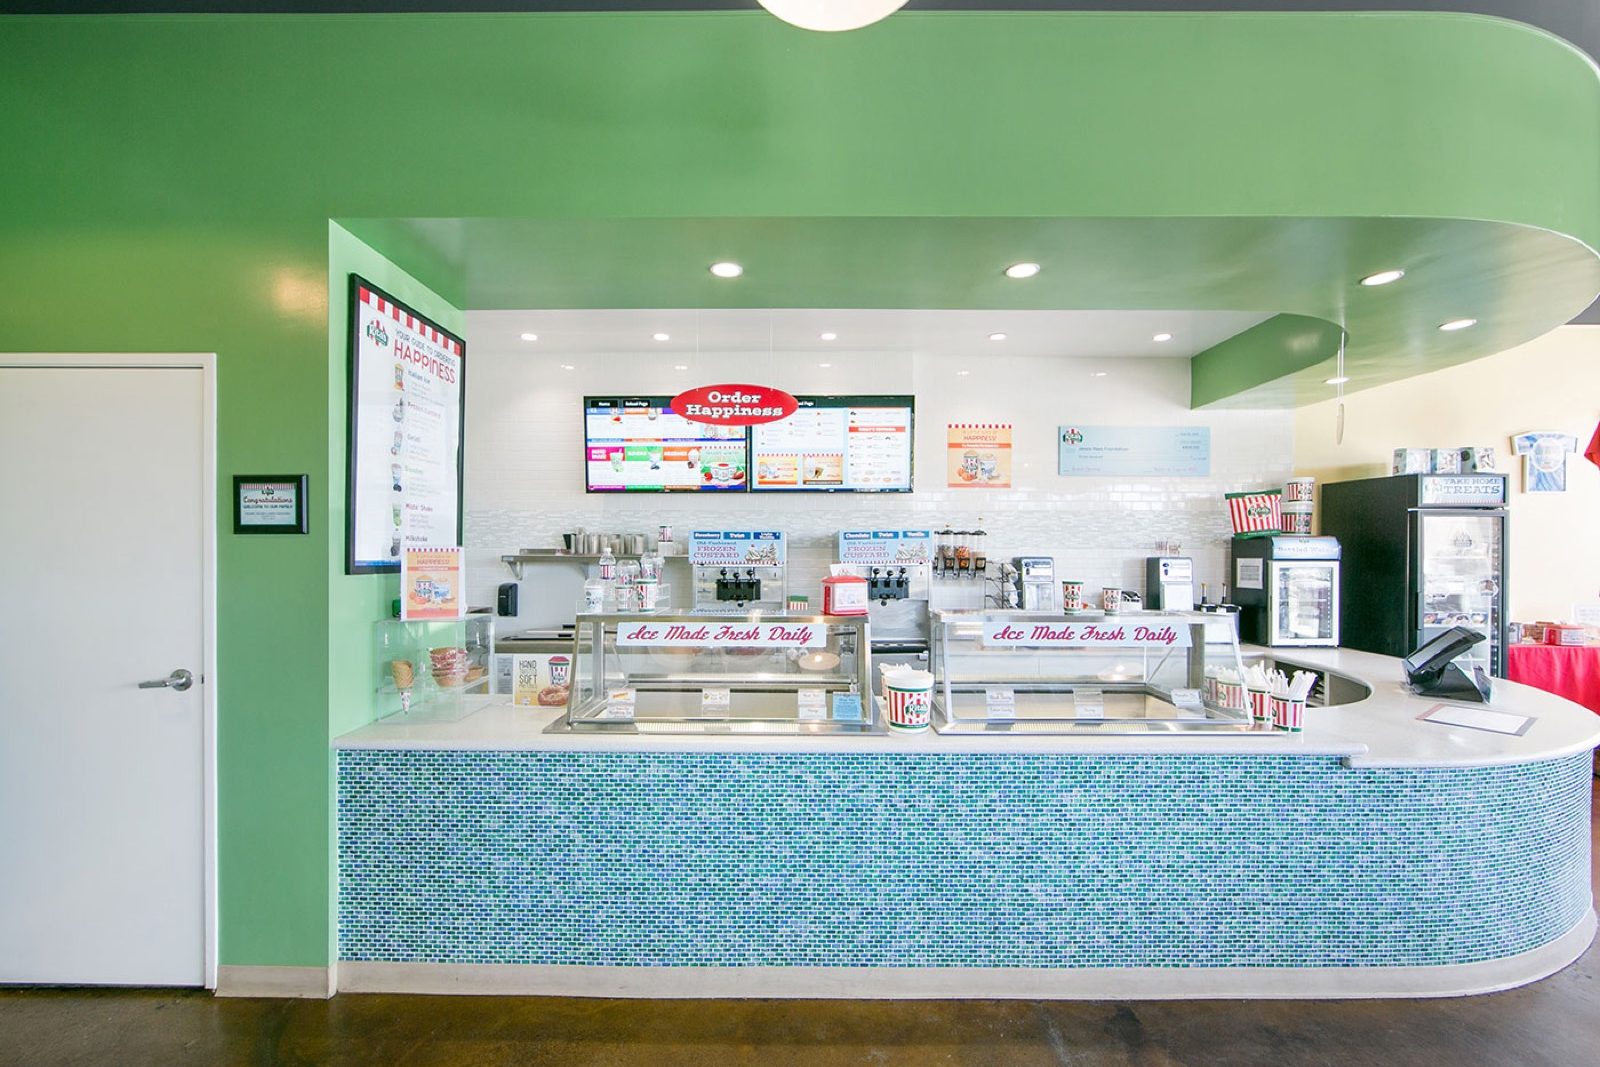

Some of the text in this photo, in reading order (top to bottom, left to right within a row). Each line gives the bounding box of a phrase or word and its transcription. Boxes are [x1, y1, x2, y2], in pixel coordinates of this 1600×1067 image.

[396, 330, 410, 341] YOUR
[708, 391, 761, 403] Order
[686, 404, 783, 418] Happiness
[1443, 485, 1500, 494] TREATS
[626, 625, 813, 645] Ice Made Fresh Daily
[993, 625, 1178, 644] Ice Made Fresh Daily
[519, 660, 537, 669] HAND
[519, 674, 537, 684] SOFT
